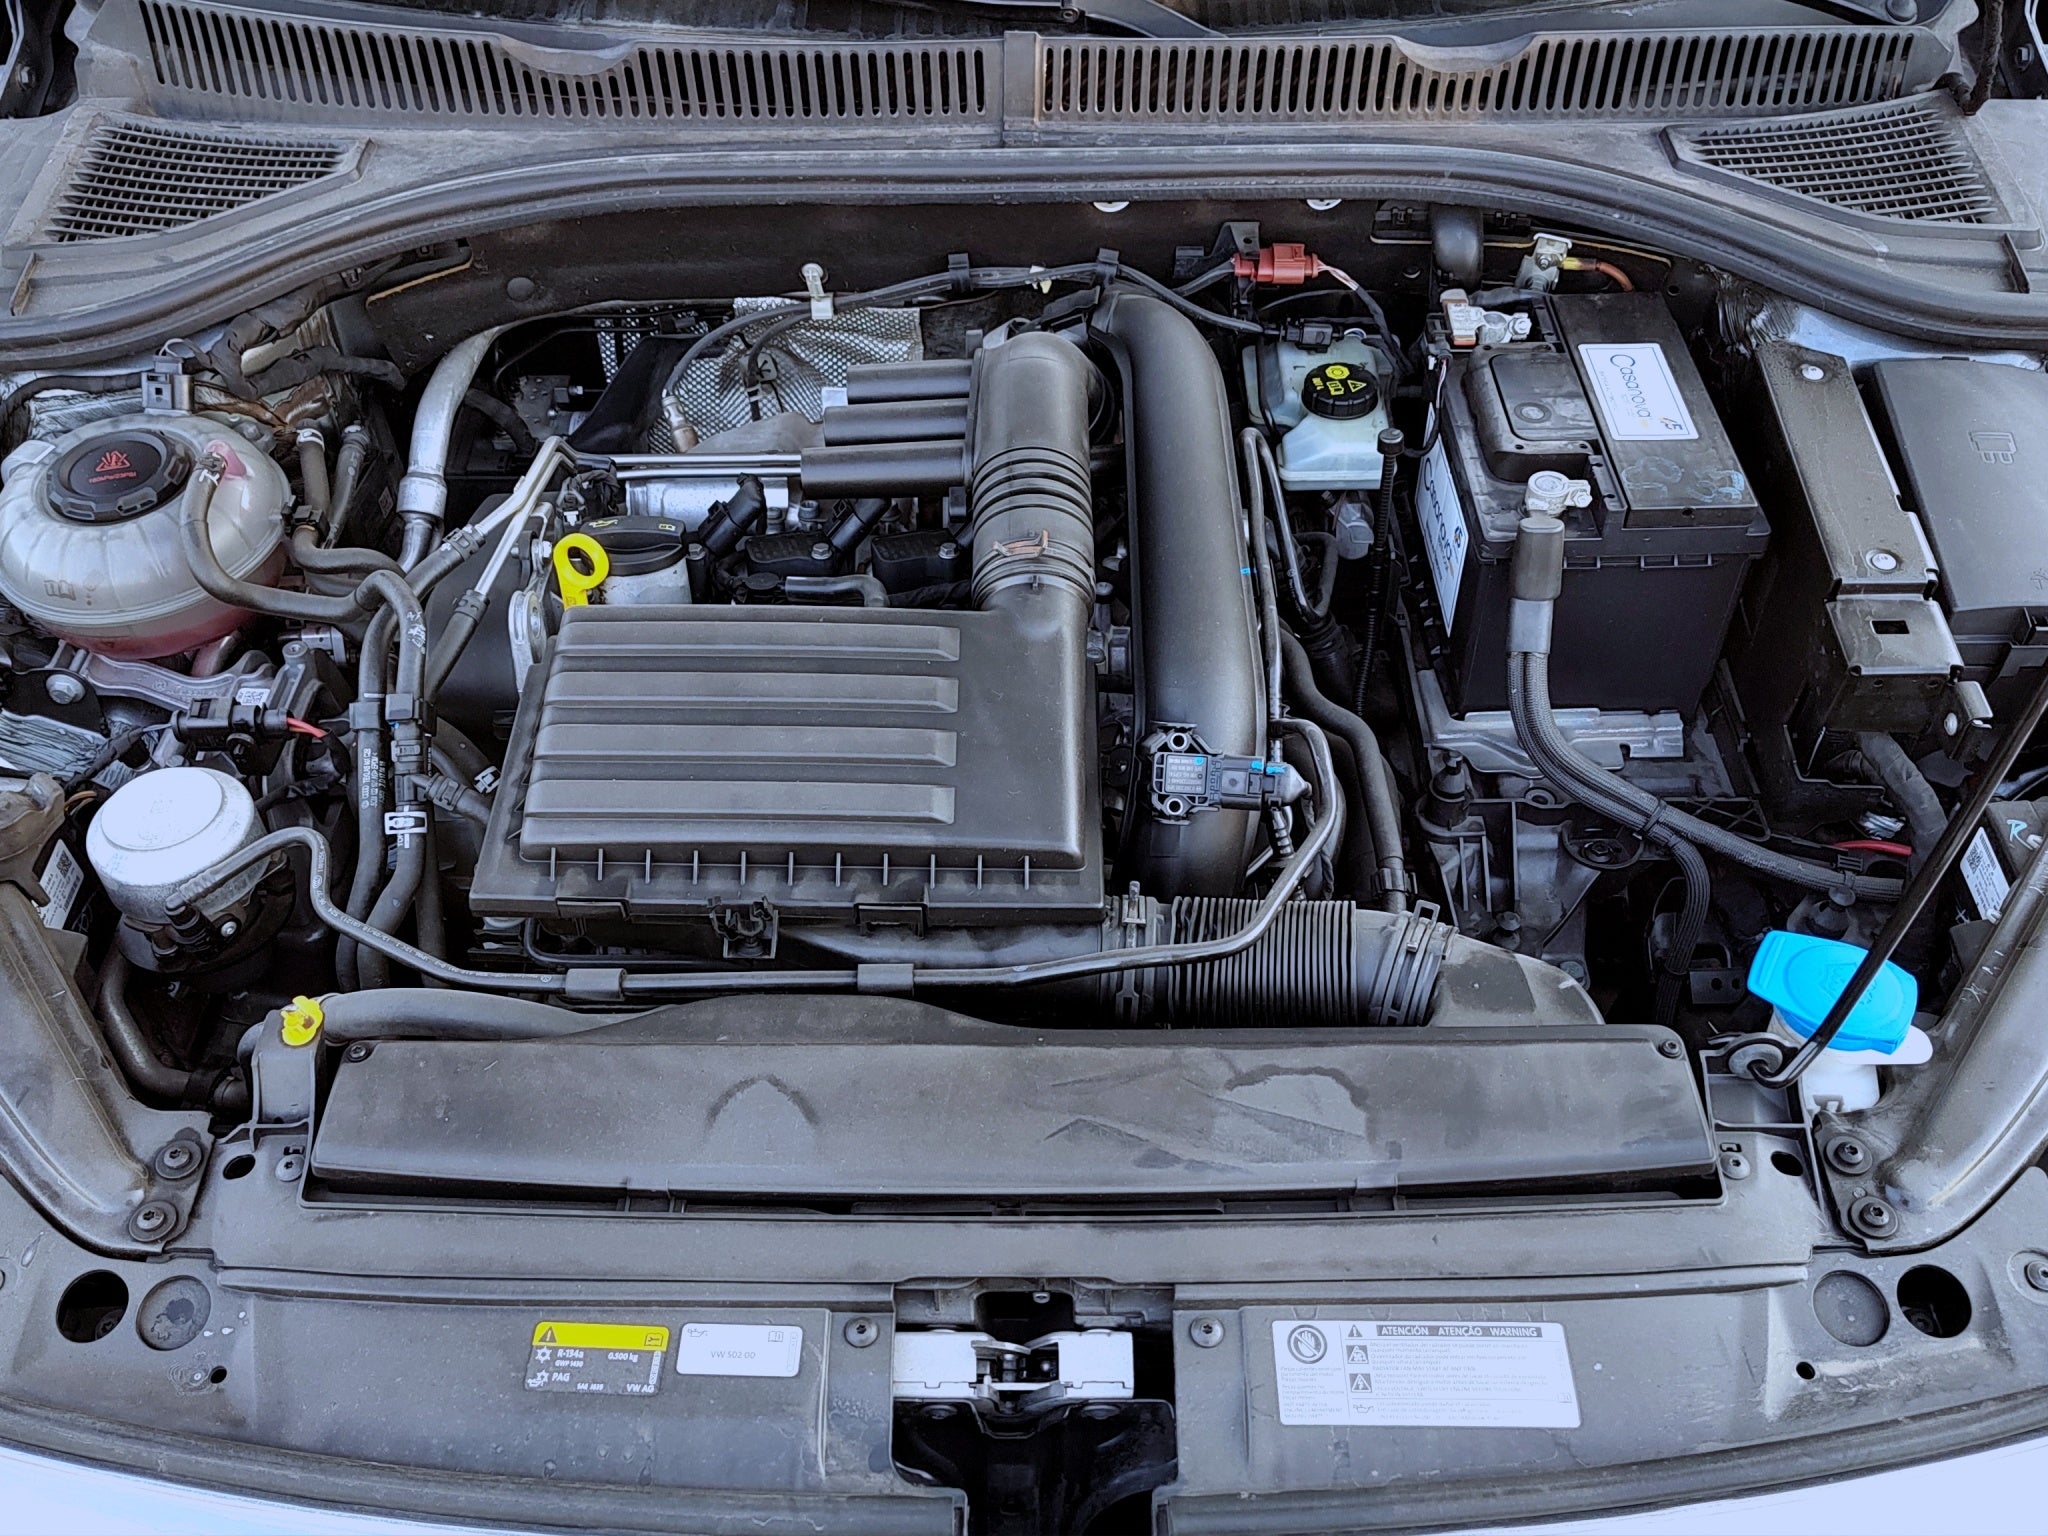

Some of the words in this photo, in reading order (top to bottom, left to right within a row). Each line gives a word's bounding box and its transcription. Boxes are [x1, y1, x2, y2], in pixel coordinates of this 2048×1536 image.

[1610, 354, 1651, 417] Casanova
[1381, 1325, 1429, 1336] ATENCIÓN
[1437, 1325, 1483, 1337] ATENÇÃO
[1489, 1327, 1537, 1337] WARNING
[629, 1353, 639, 1363] kg
[711, 1351, 725, 1359] VW
[727, 1351, 742, 1359] 502
[551, 1372, 570, 1382] PAG
[626, 1383, 640, 1392] VW
[641, 1384, 655, 1393] AG
